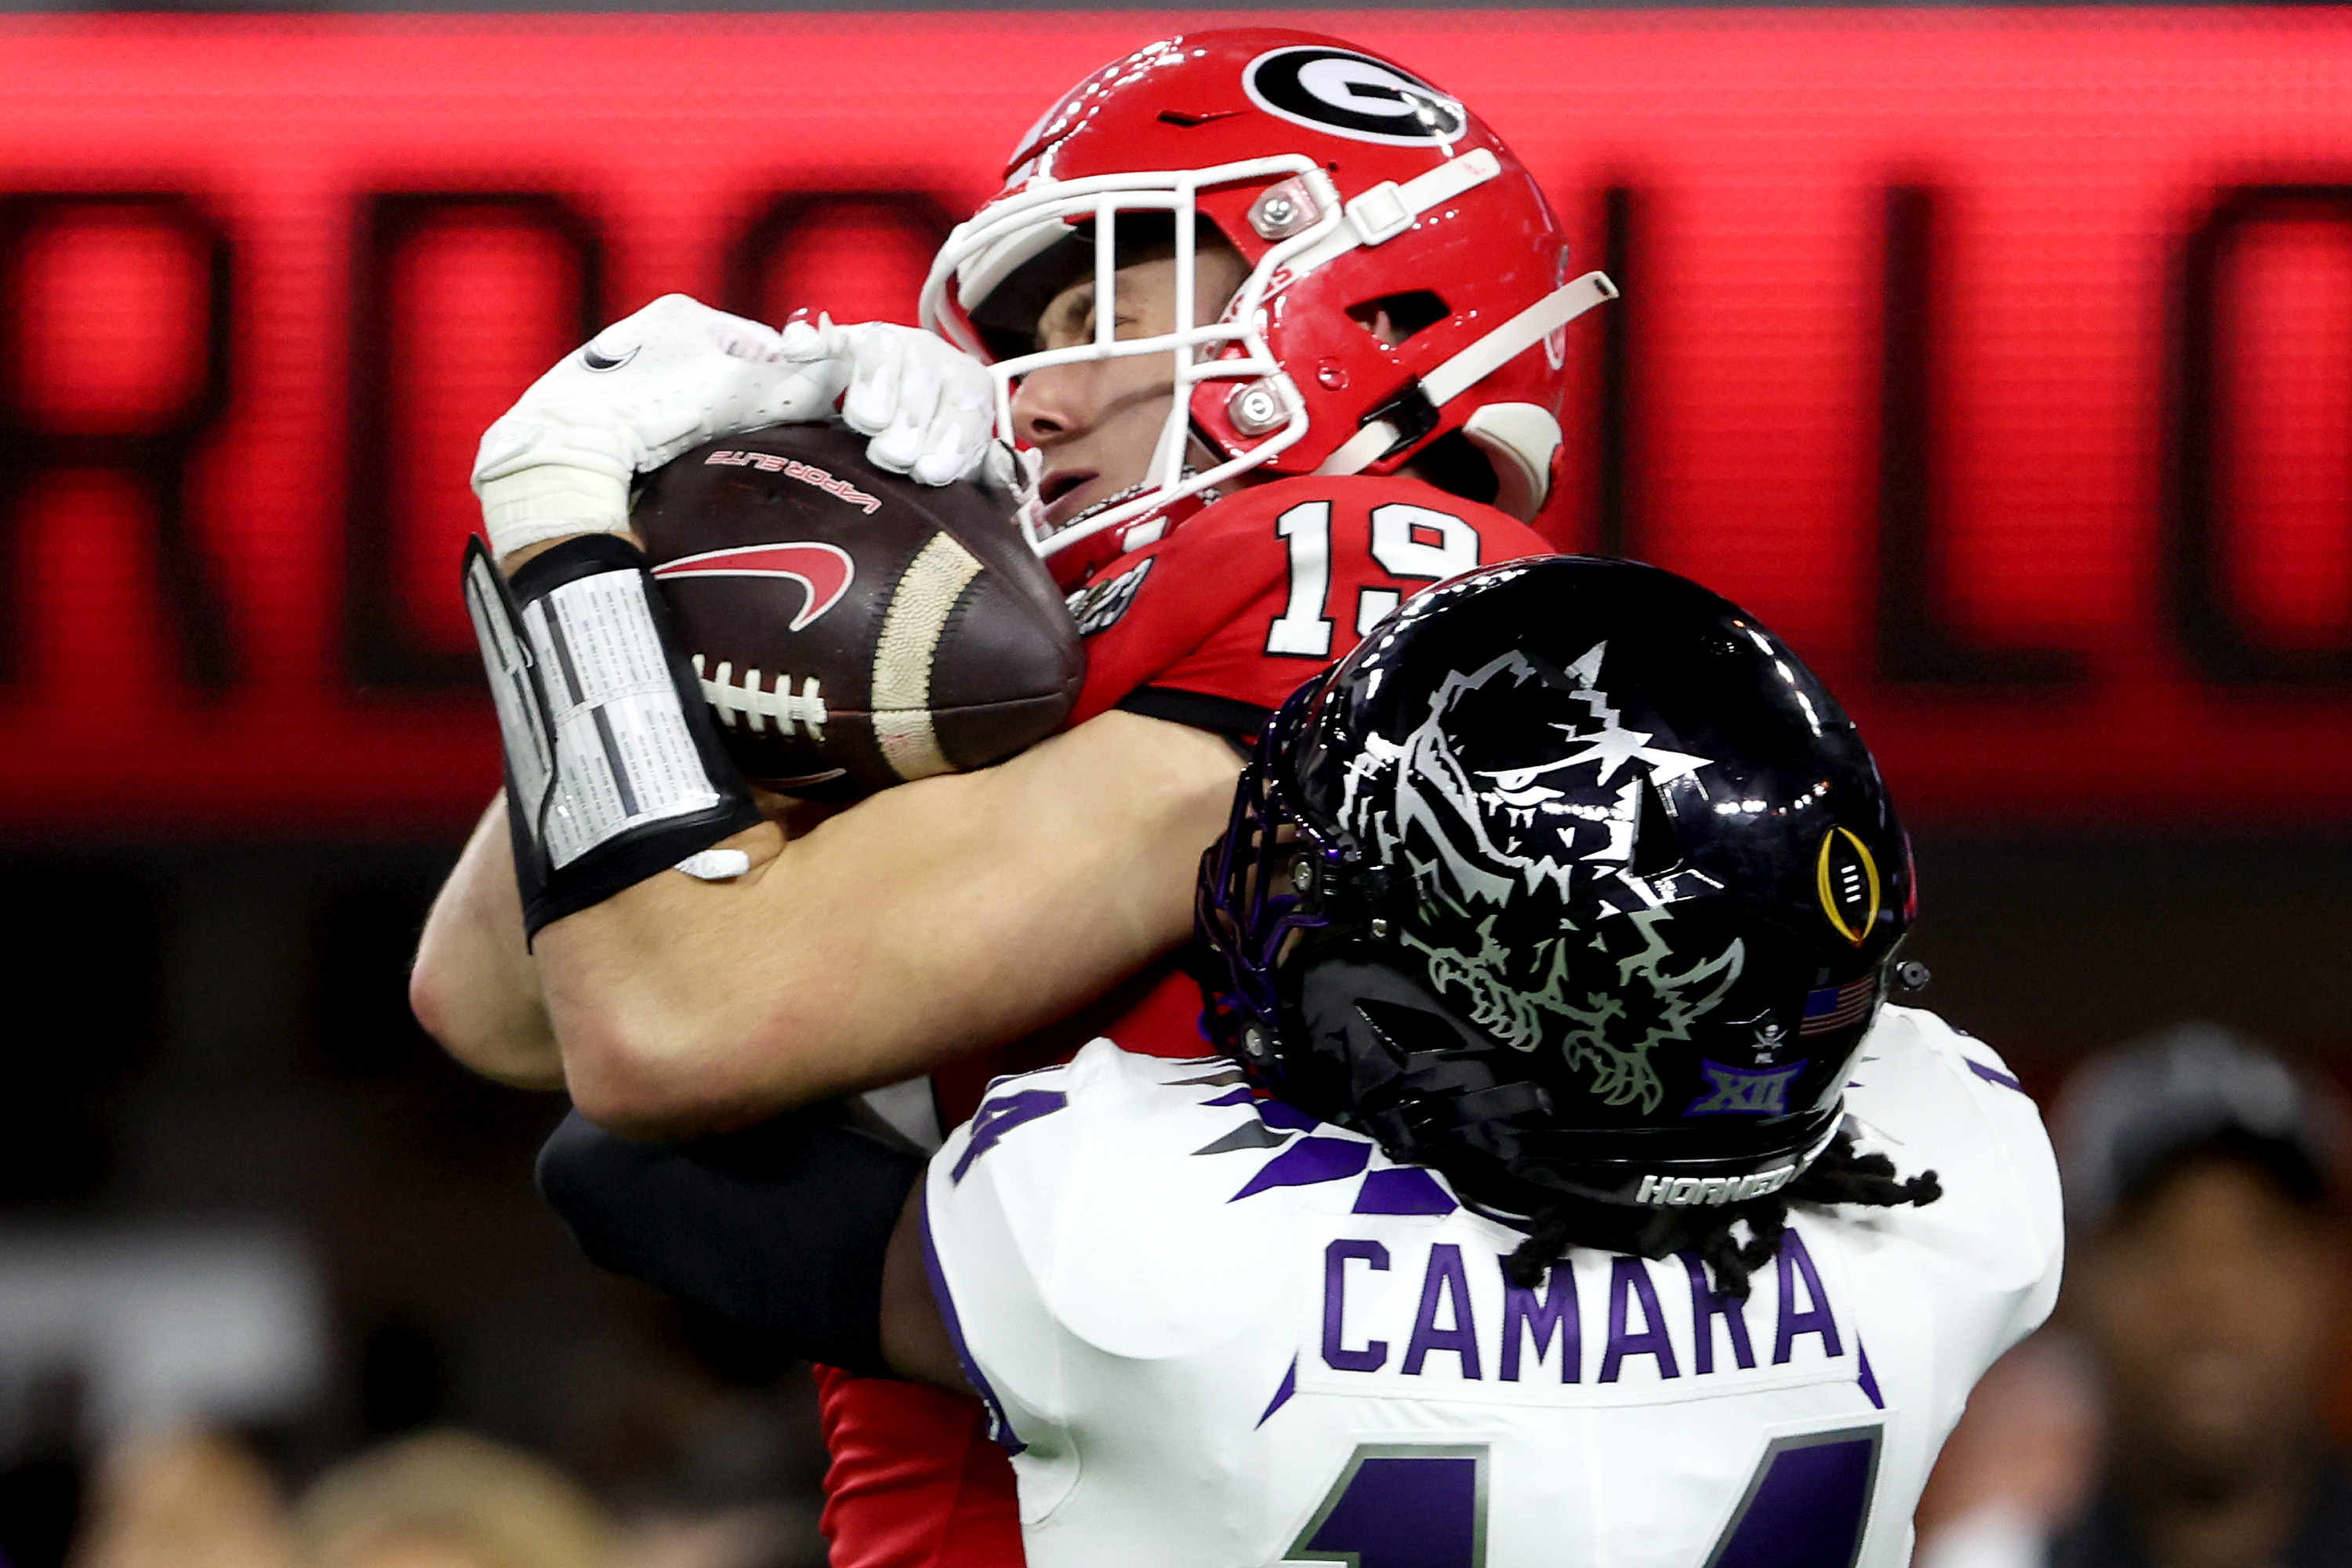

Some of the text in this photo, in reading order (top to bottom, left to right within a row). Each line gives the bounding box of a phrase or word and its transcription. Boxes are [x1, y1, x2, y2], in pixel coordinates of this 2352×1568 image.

[1243, 46, 1465, 143] G
[704, 450, 883, 515] VAPOR ELITE
[1265, 500, 1480, 657] 19
